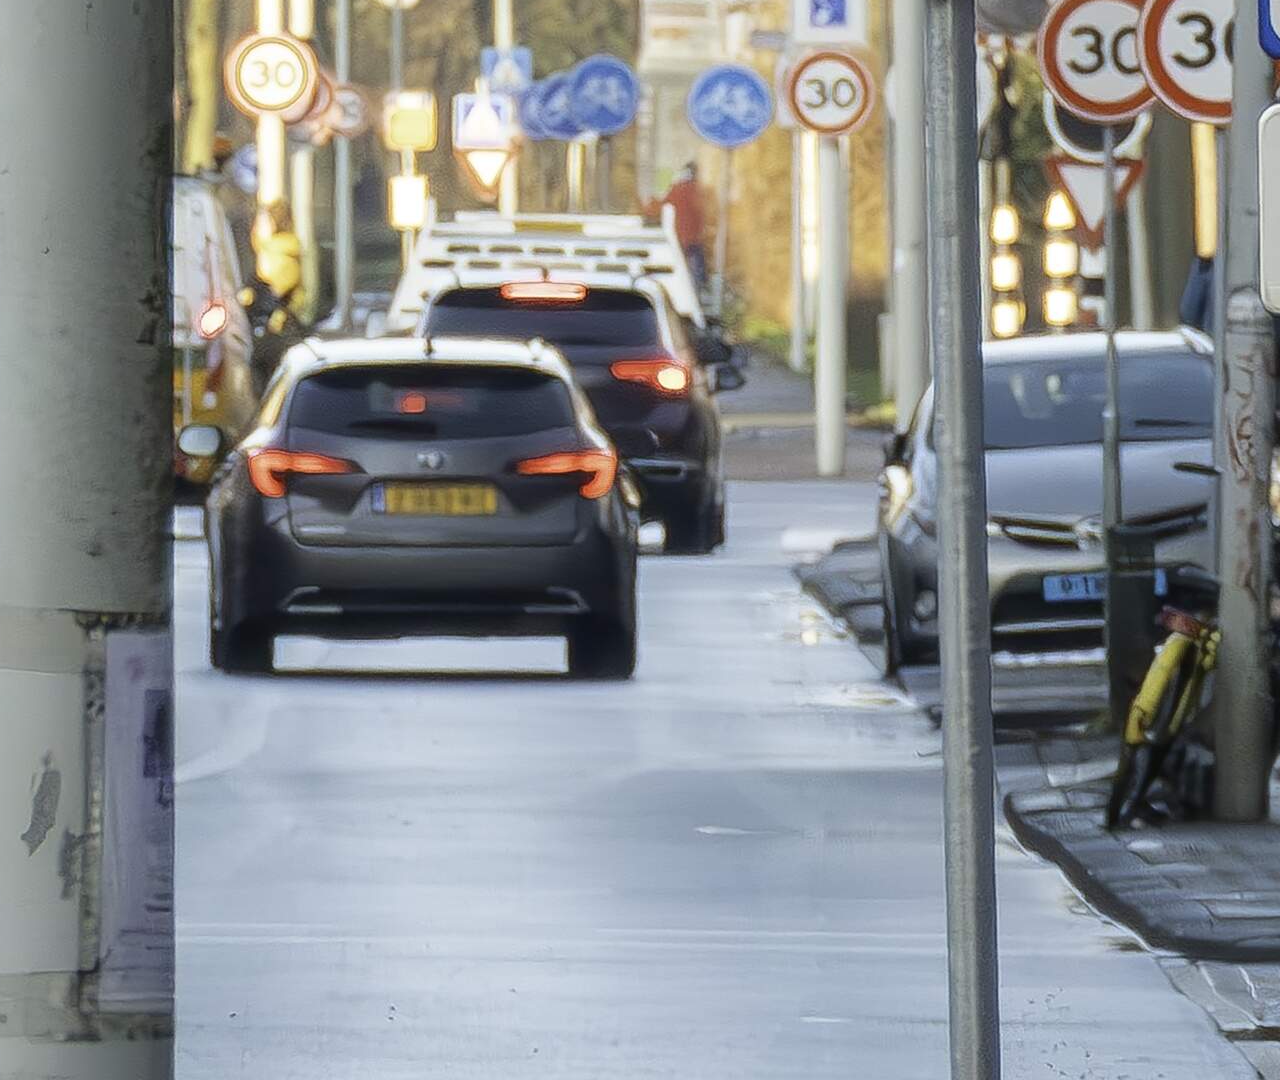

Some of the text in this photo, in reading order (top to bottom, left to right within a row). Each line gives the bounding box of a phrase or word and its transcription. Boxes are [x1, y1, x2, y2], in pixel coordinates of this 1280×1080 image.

[1172, 13, 1235, 68] 3
[249, 59, 297, 88] 30
[802, 77, 857, 109] 30
